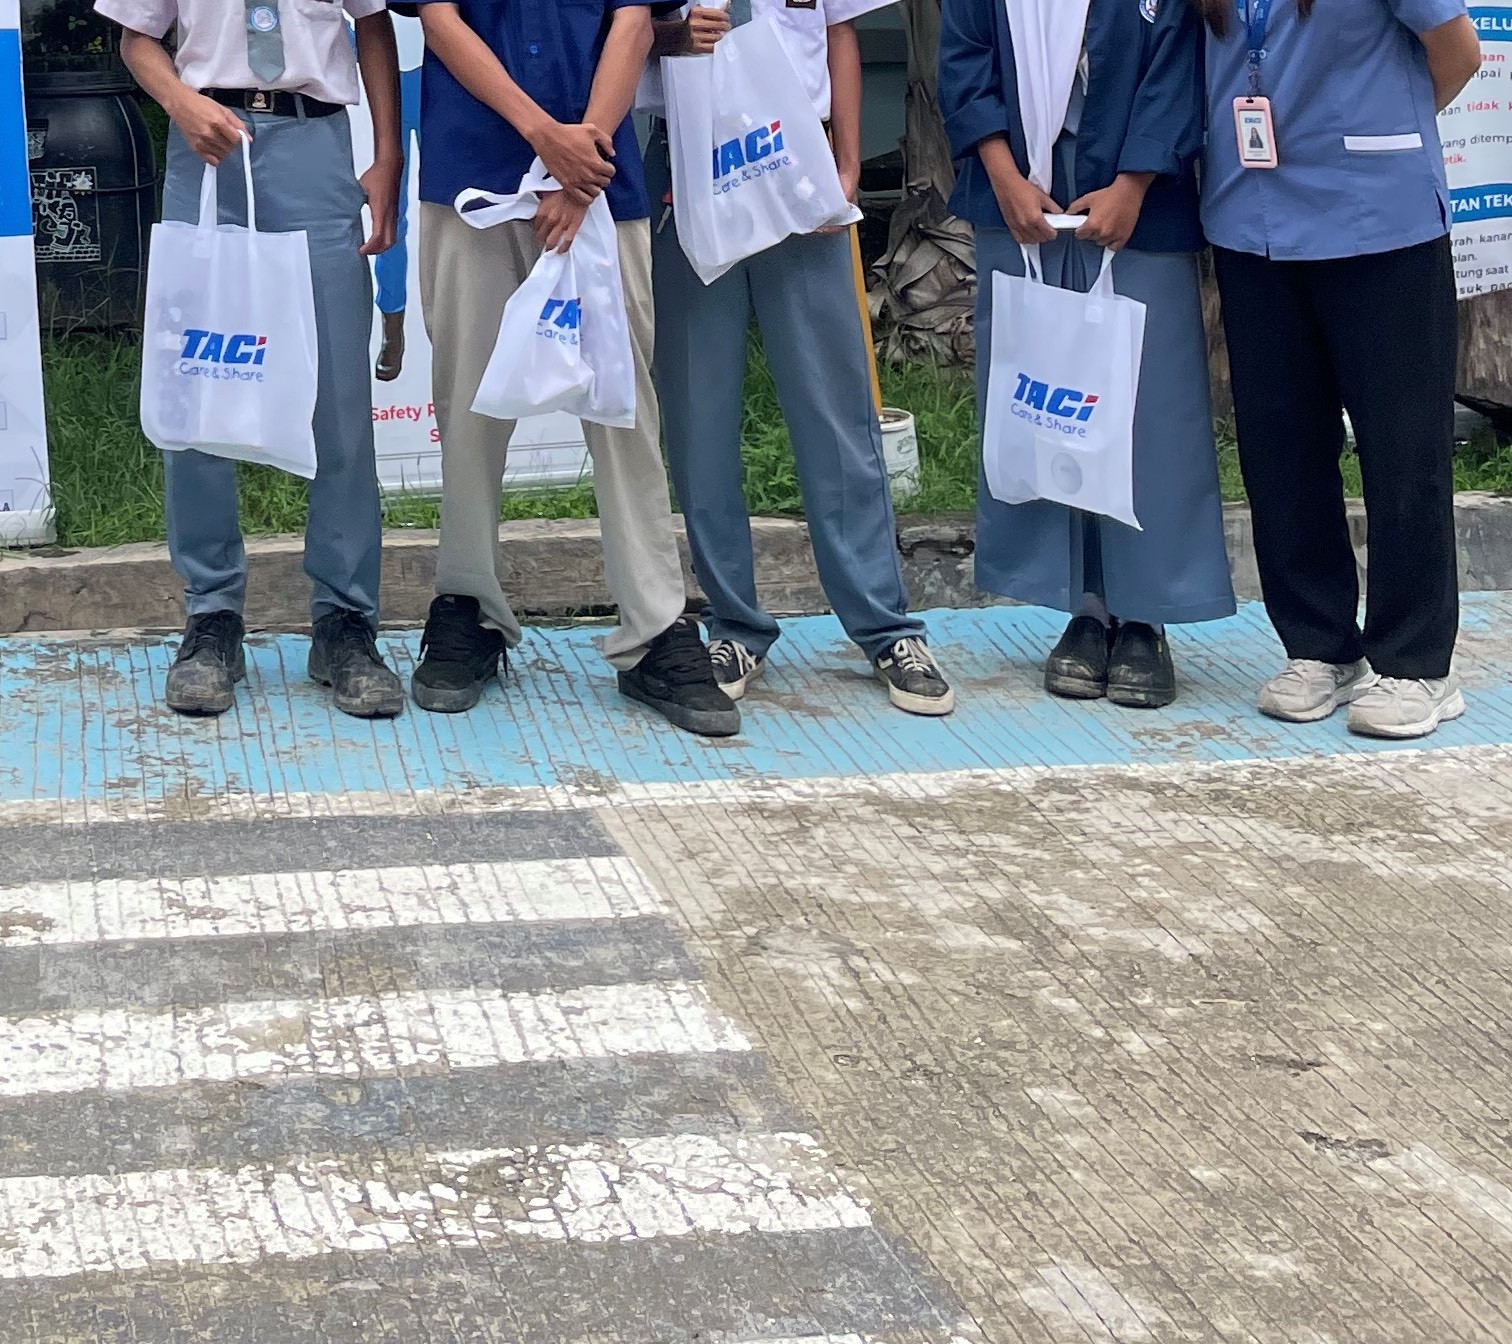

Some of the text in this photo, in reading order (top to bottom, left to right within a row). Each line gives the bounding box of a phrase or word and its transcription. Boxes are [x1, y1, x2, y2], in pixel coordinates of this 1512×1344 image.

[1467, 101, 1499, 113] tidak
[752, 156, 791, 177] Share
[1449, 193, 1512, 212] TAN TEK
[1486, 265, 1508, 275] saat
[179, 362, 209, 378] Care
[222, 367, 264, 383] Share
[371, 405, 422, 421] Safety
[1045, 417, 1087, 438] Share
